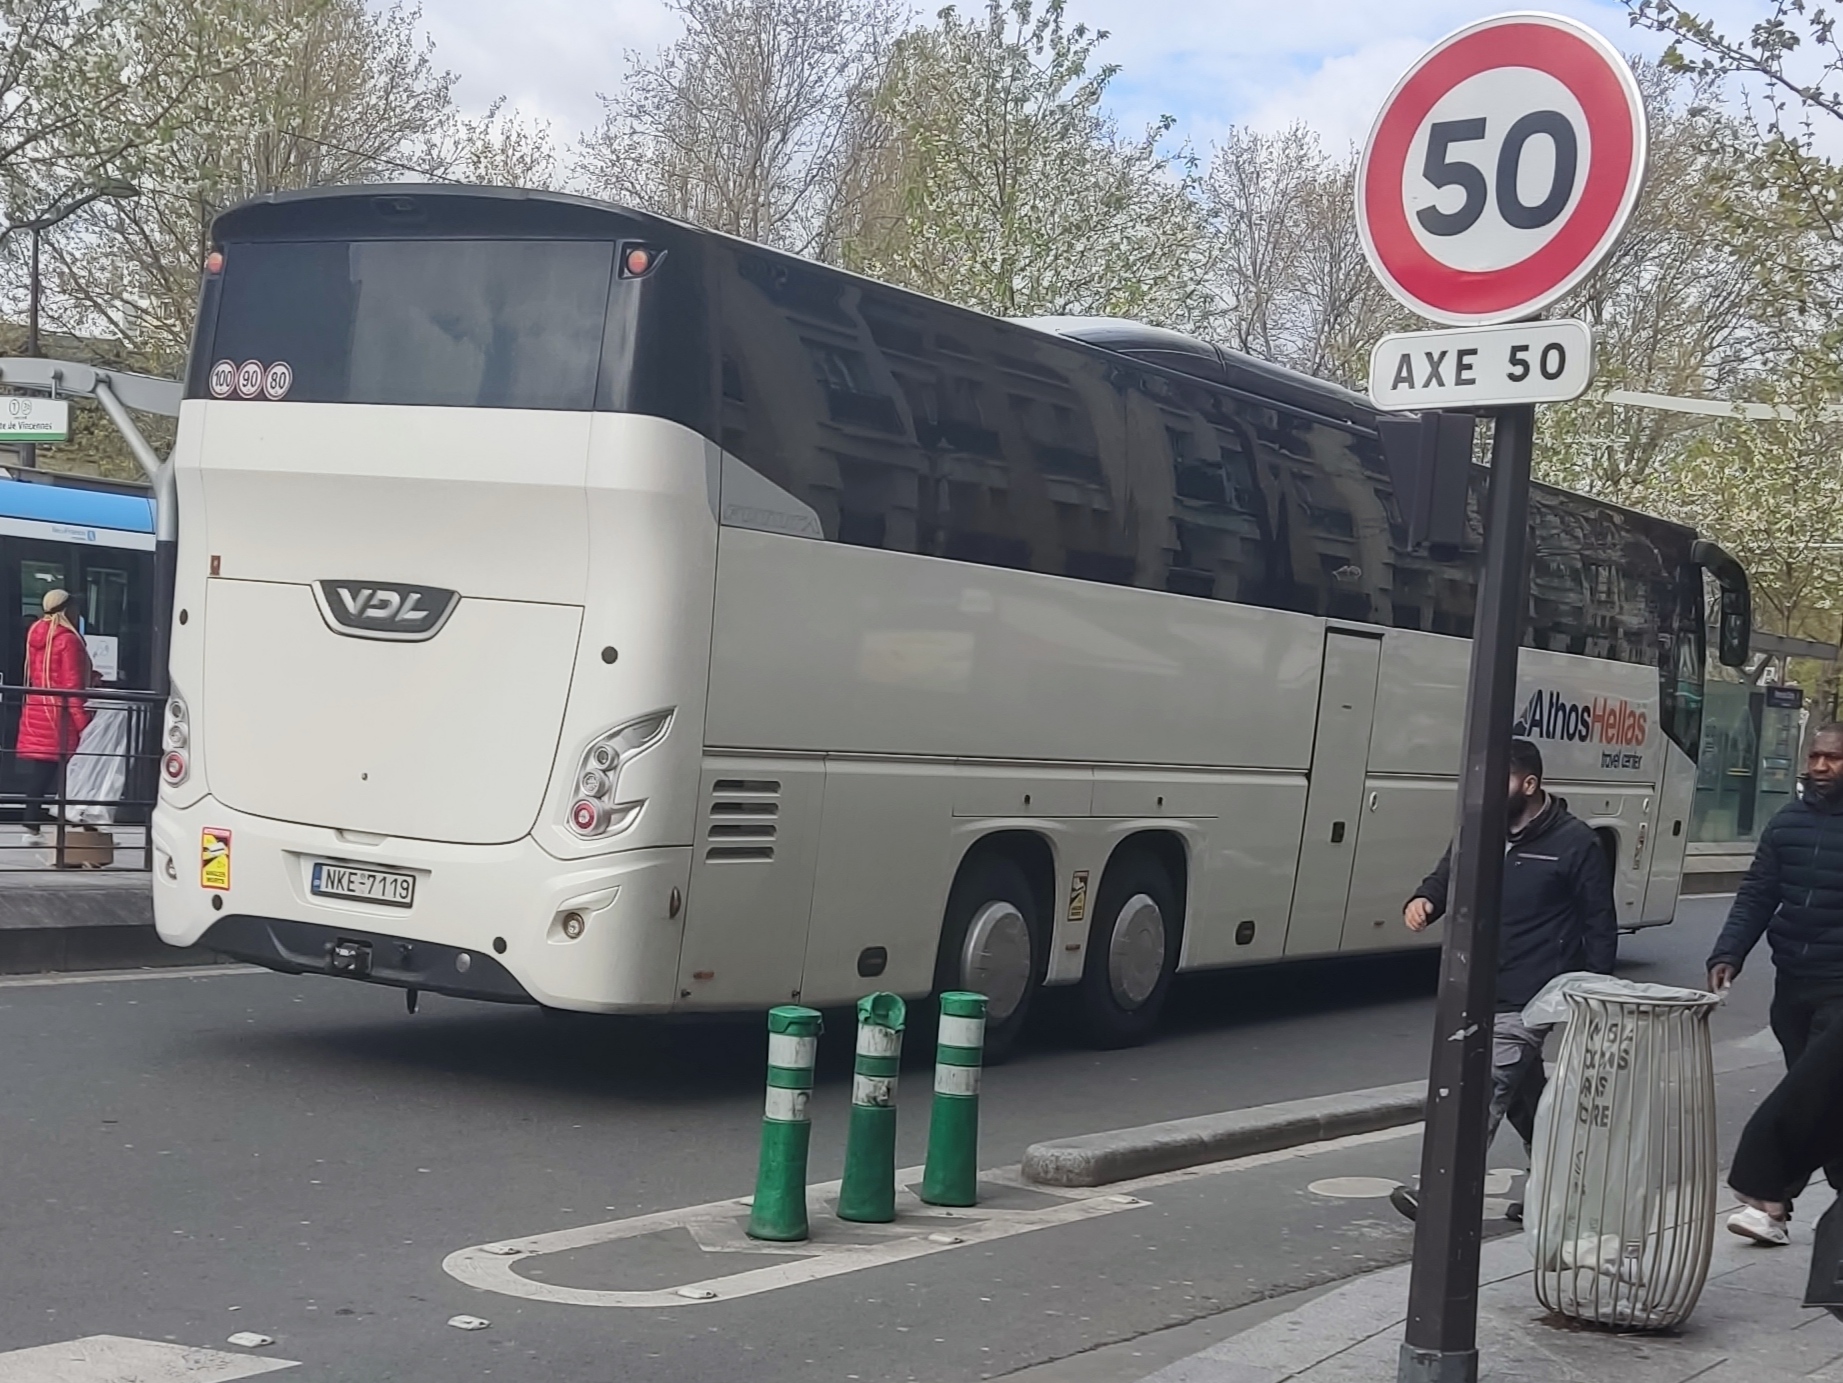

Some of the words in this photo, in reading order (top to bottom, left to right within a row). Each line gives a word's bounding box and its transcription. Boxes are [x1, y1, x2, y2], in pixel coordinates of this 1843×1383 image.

[1416, 110, 1578, 237] 50
[214, 369, 233, 388] 100
[242, 370, 259, 388] 90
[270, 371, 287, 389] 80
[1390, 347, 1479, 391] AXE
[1506, 342, 1567, 383] 50
[335, 587, 430, 622] VDL
